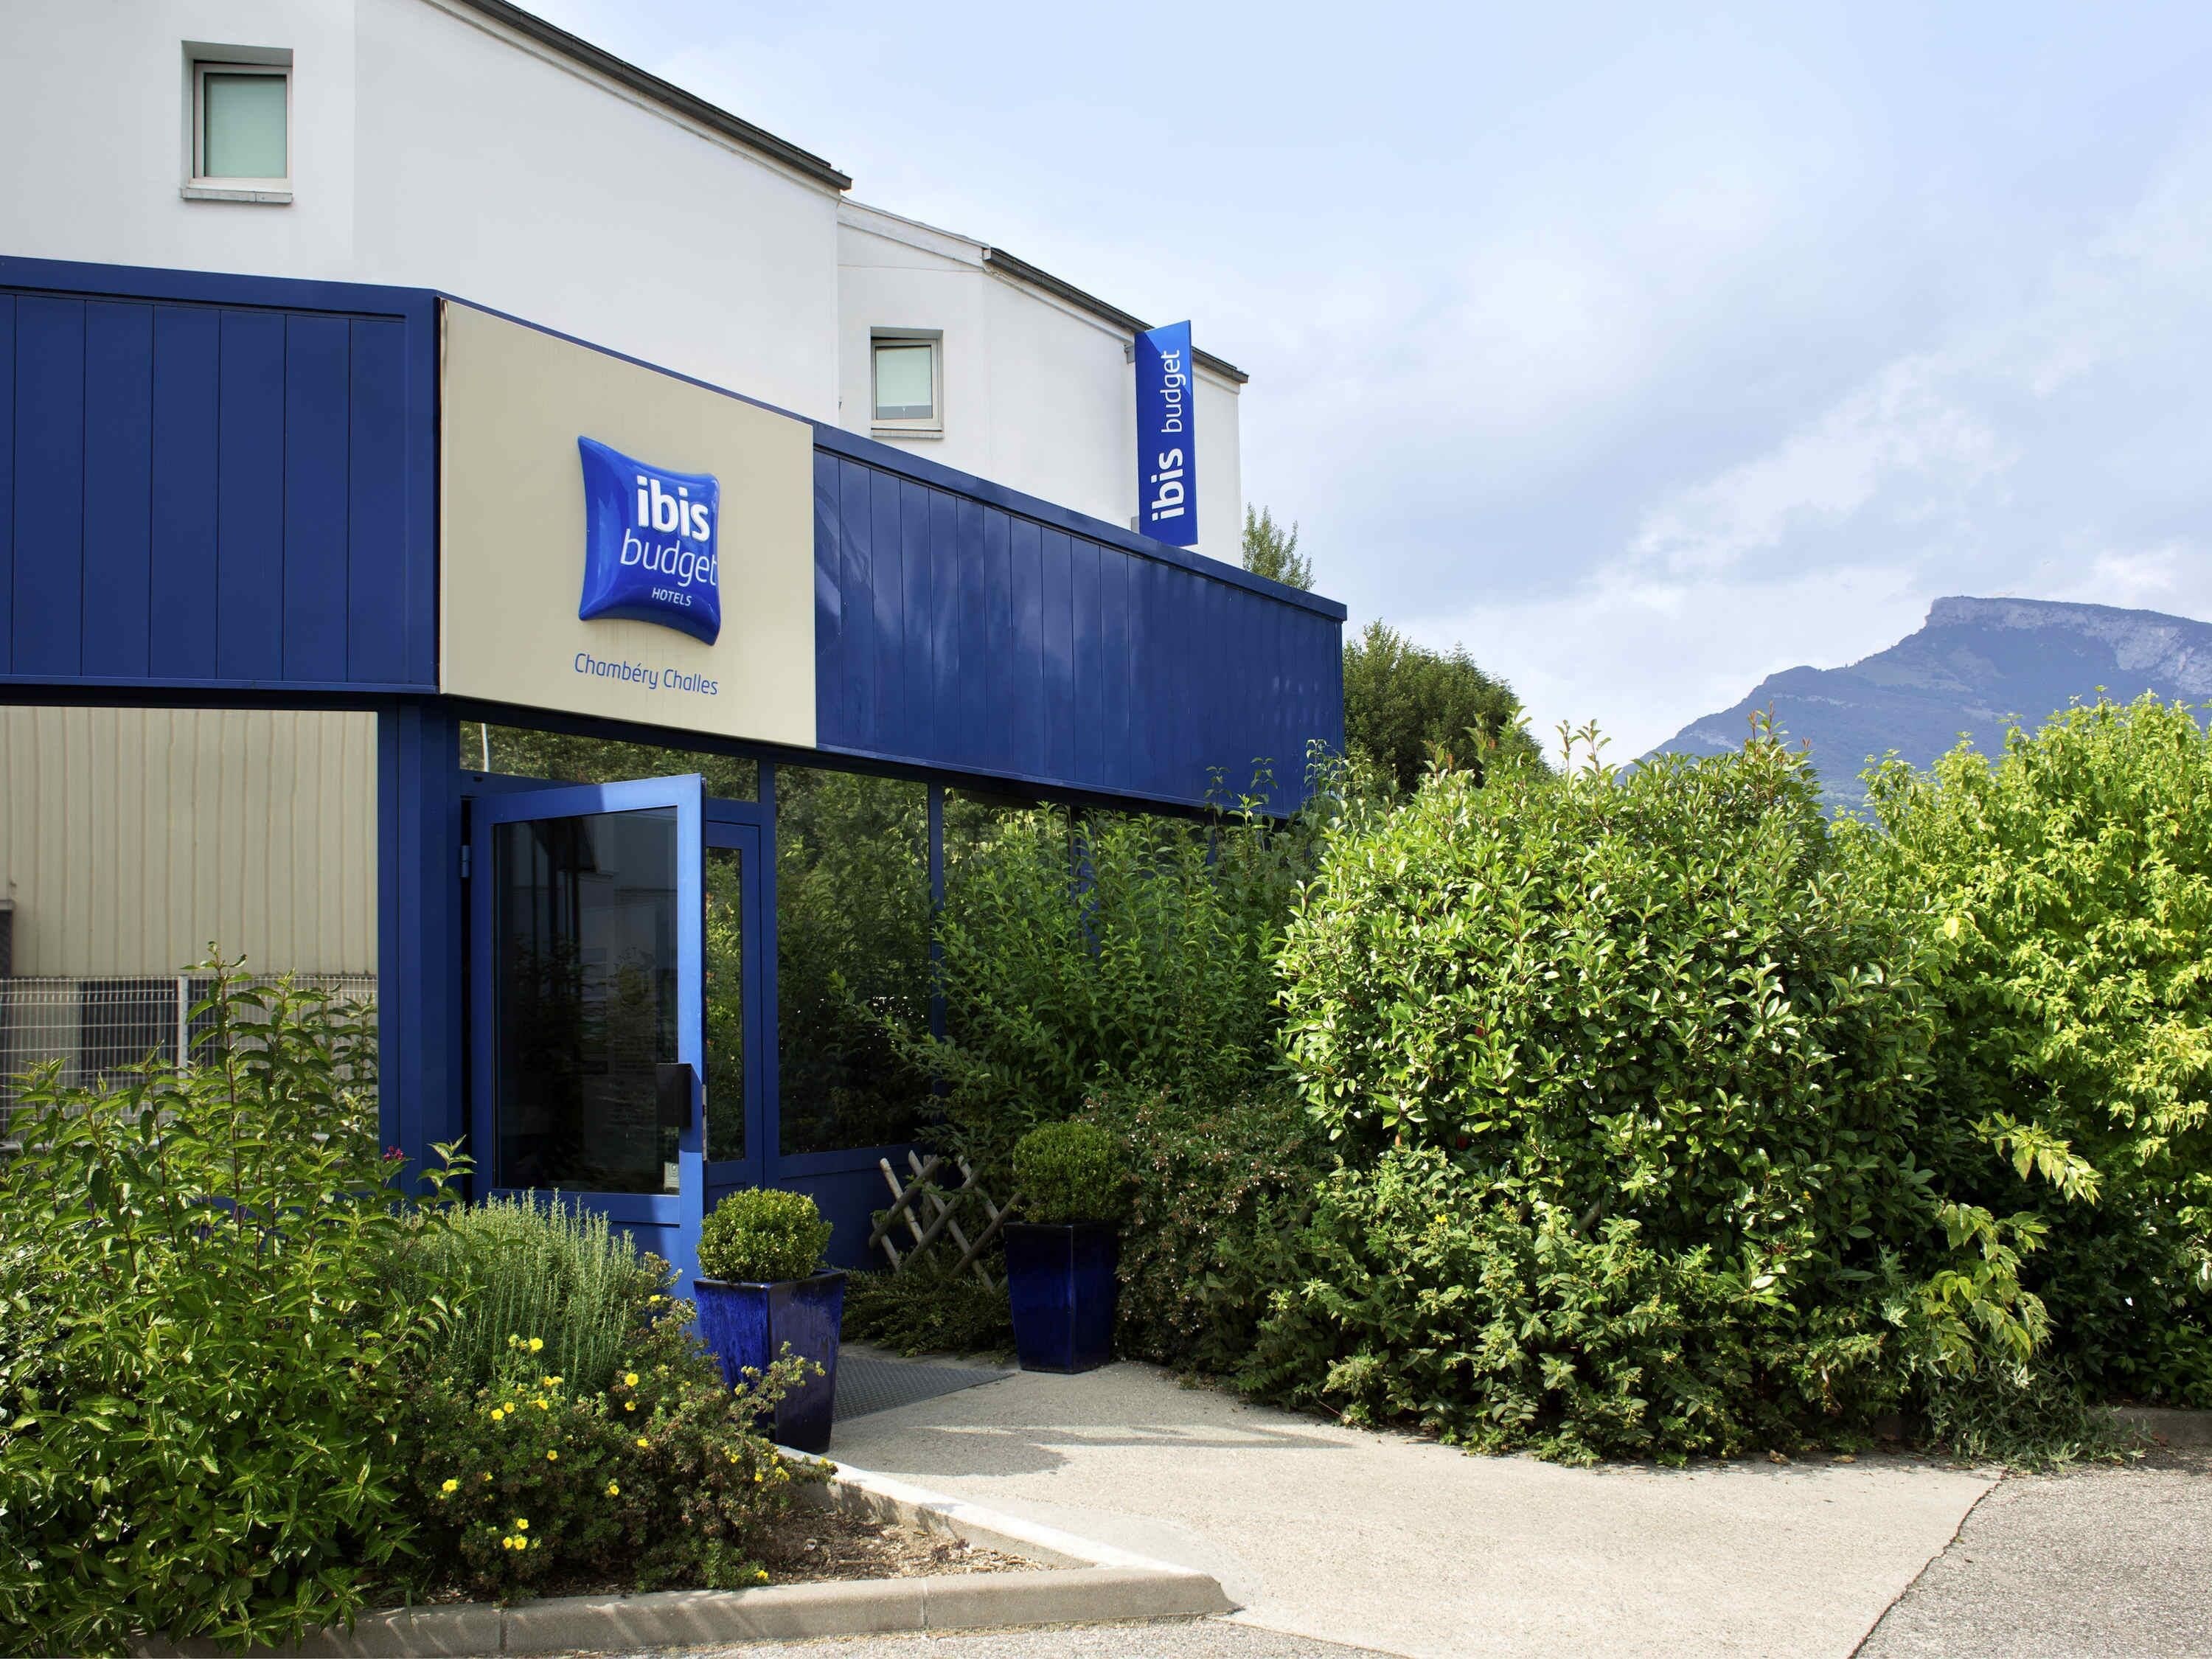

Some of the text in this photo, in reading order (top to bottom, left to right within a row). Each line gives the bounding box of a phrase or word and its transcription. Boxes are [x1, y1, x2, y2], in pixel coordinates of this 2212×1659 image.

[1151, 349, 1186, 521] ibis budget
[636, 474, 711, 542] ibis
[619, 528, 718, 587] budget
[651, 587, 692, 606] HOTELS
[574, 653, 719, 695] Chambéry Challes
